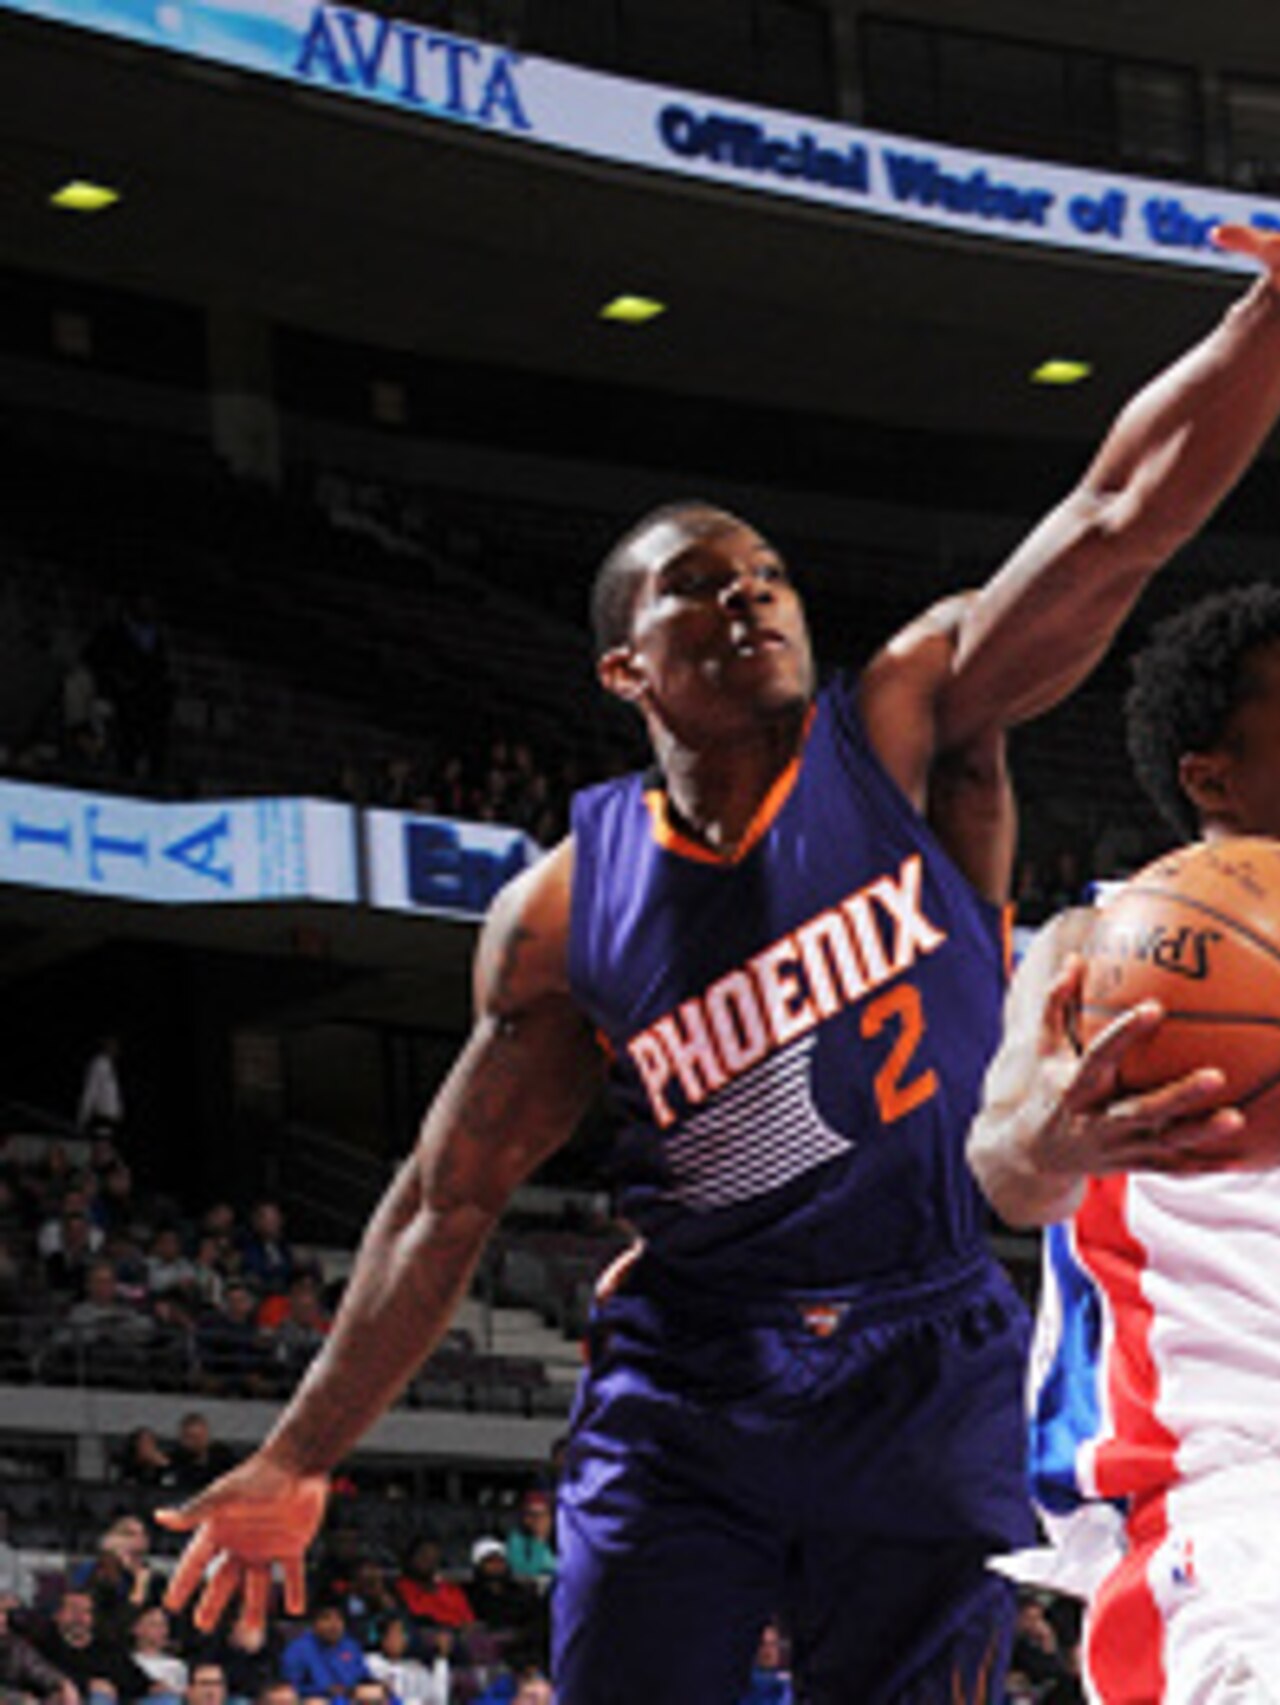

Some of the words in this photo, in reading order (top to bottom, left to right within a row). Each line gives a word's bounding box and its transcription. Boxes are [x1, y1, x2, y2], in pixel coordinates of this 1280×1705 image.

[294, 5, 532, 130] AVITA
[658, 104, 869, 193] Official
[882, 149, 1055, 225] Water
[1067, 190, 1127, 237] of
[626, 852, 948, 1129] PHOENIX
[859, 983, 939, 1124] 2
